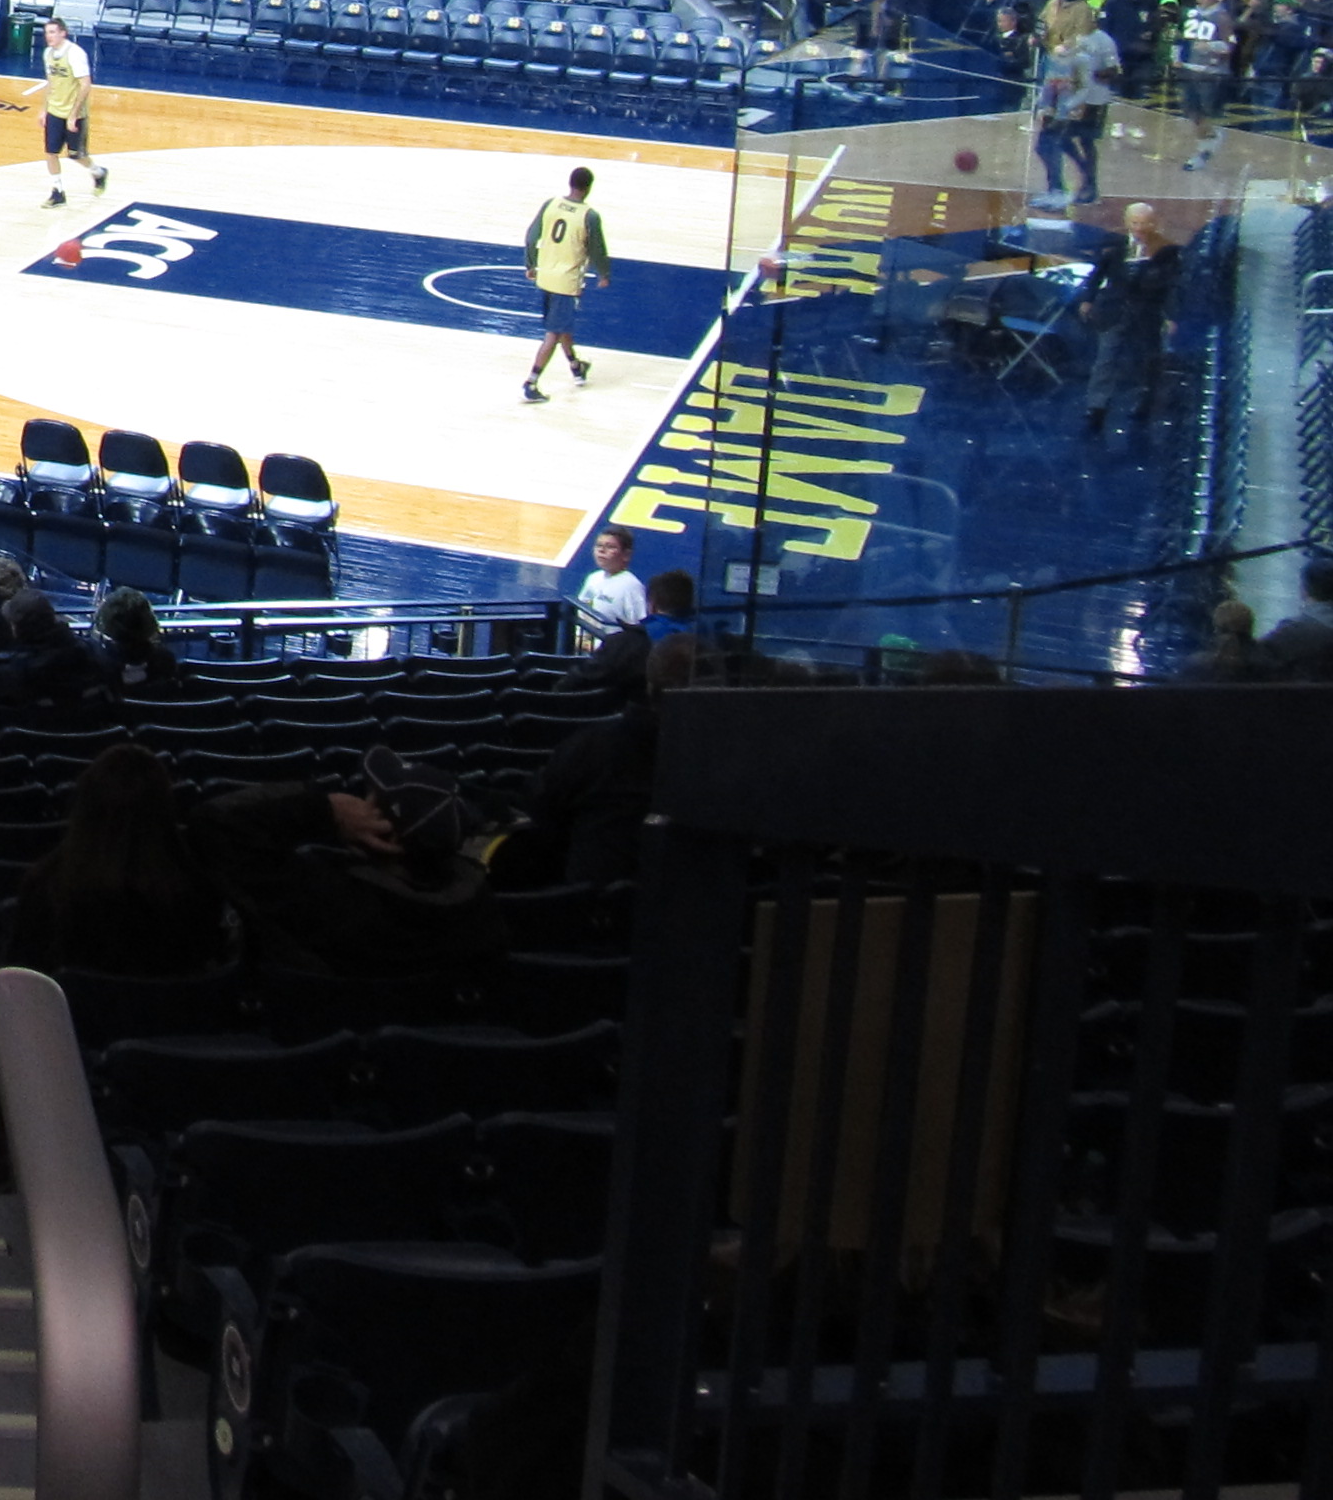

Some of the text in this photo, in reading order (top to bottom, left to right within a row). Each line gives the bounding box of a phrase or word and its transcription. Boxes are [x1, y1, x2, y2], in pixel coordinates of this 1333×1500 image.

[1182, 19, 1218, 41] 20
[75, 208, 219, 280] ACC
[551, 218, 567, 244] 0
[609, 360, 927, 561] DAME
